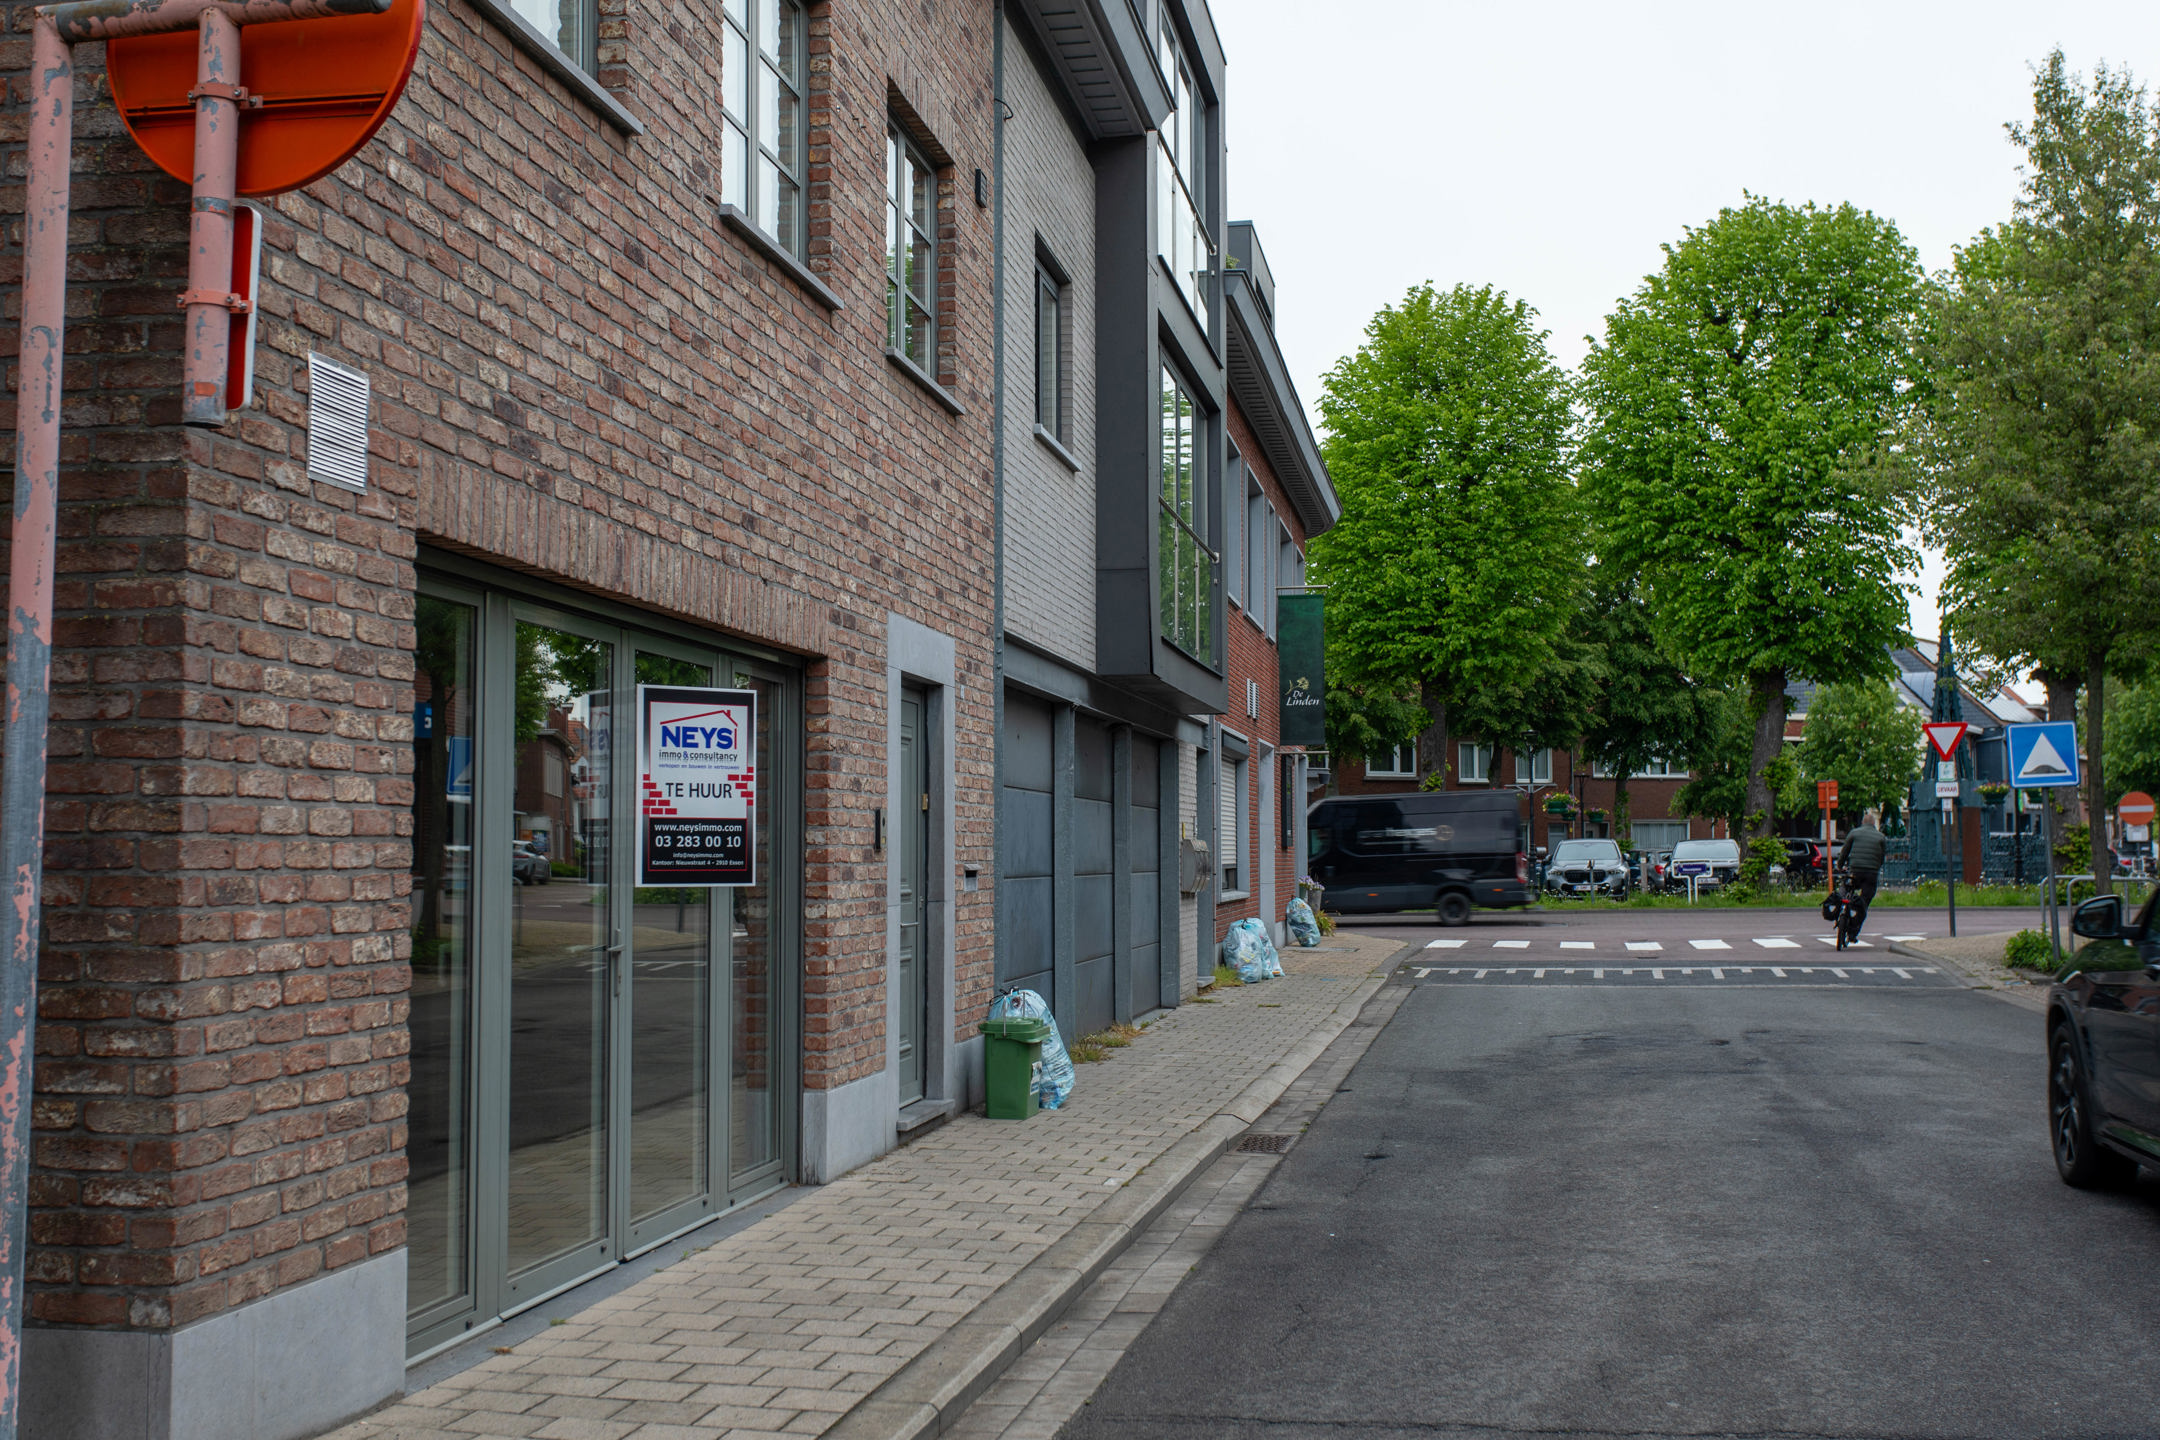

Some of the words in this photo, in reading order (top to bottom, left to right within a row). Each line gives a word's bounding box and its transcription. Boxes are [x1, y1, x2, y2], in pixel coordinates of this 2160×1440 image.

[1286, 695, 1319, 705] Linden
[661, 725, 733, 749] NEYS
[658, 750, 681, 759] immo
[683, 751, 688, 760] &
[690, 752, 737, 761] consultancy
[665, 782, 684, 797] TE
[689, 783, 732, 799] HUUR
[654, 823, 742, 833] www.neysimmo.com
[655, 835, 672, 847] 03
[676, 835, 700, 847] 283
[705, 836, 721, 848] 00
[726, 836, 741, 848] 10
